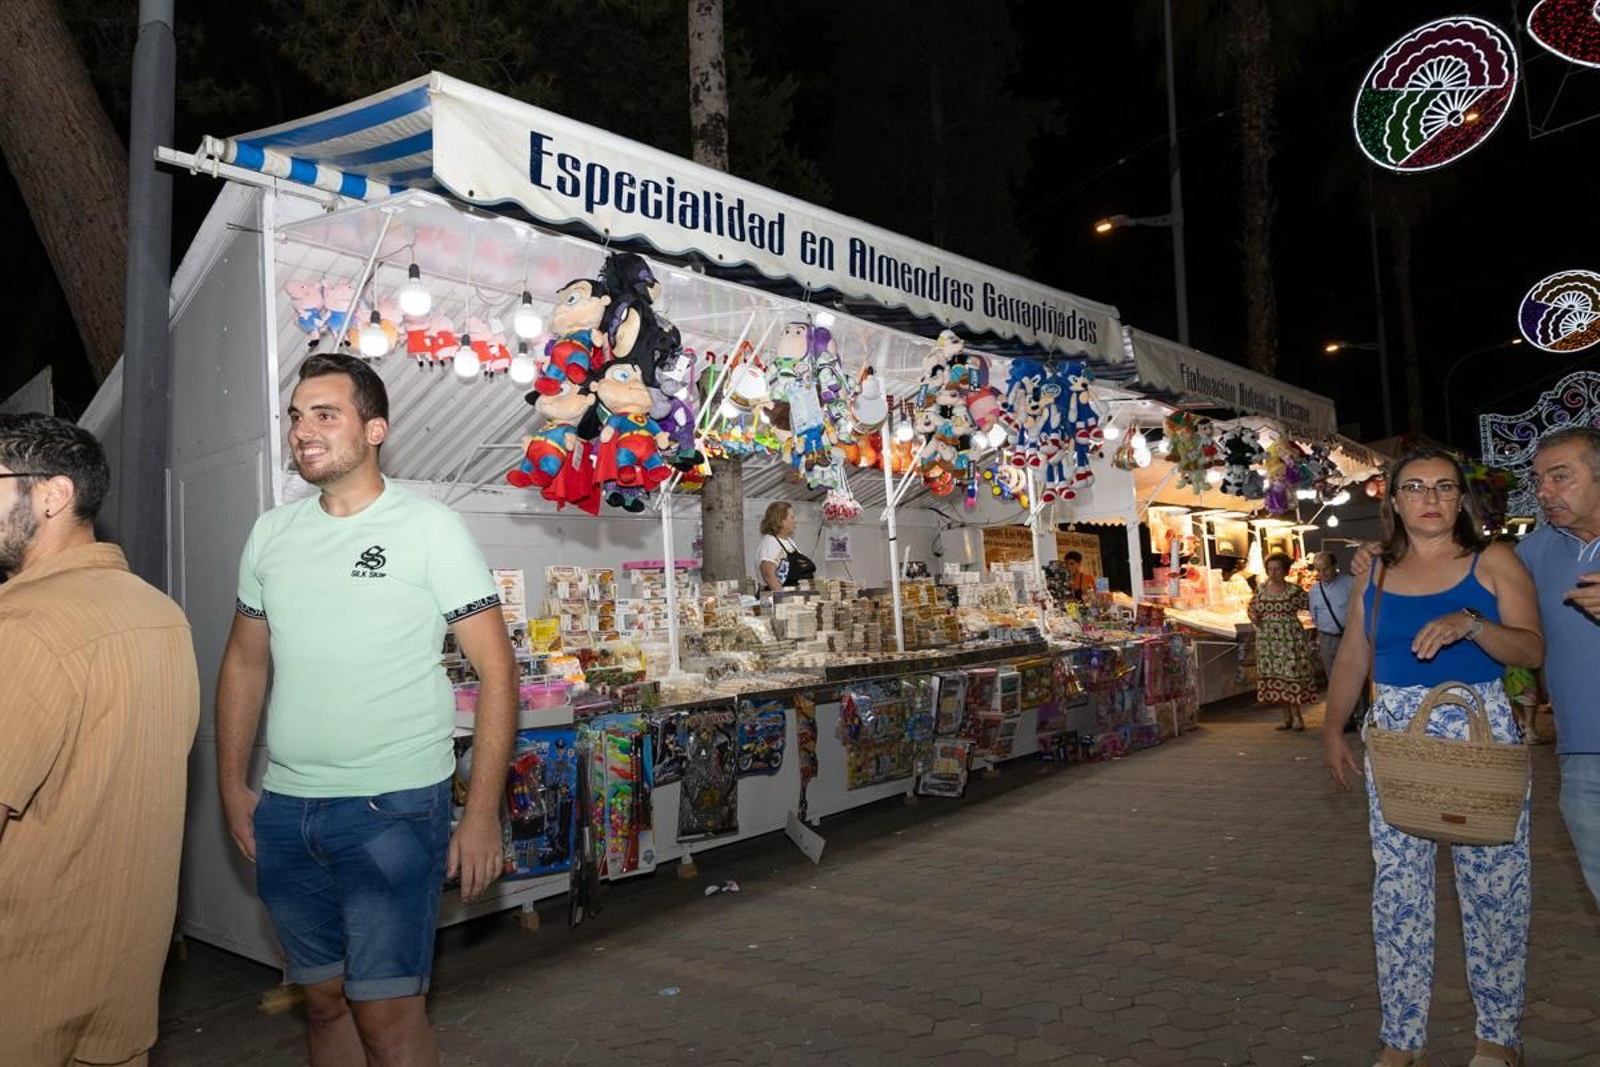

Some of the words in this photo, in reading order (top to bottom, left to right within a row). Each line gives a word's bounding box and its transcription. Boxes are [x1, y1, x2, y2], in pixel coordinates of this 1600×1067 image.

[530, 130, 785, 257] Especialidad
[800, 230, 834, 271] en
[849, 237, 974, 312] Almendras
[982, 281, 1098, 345] Garrapiñadas
